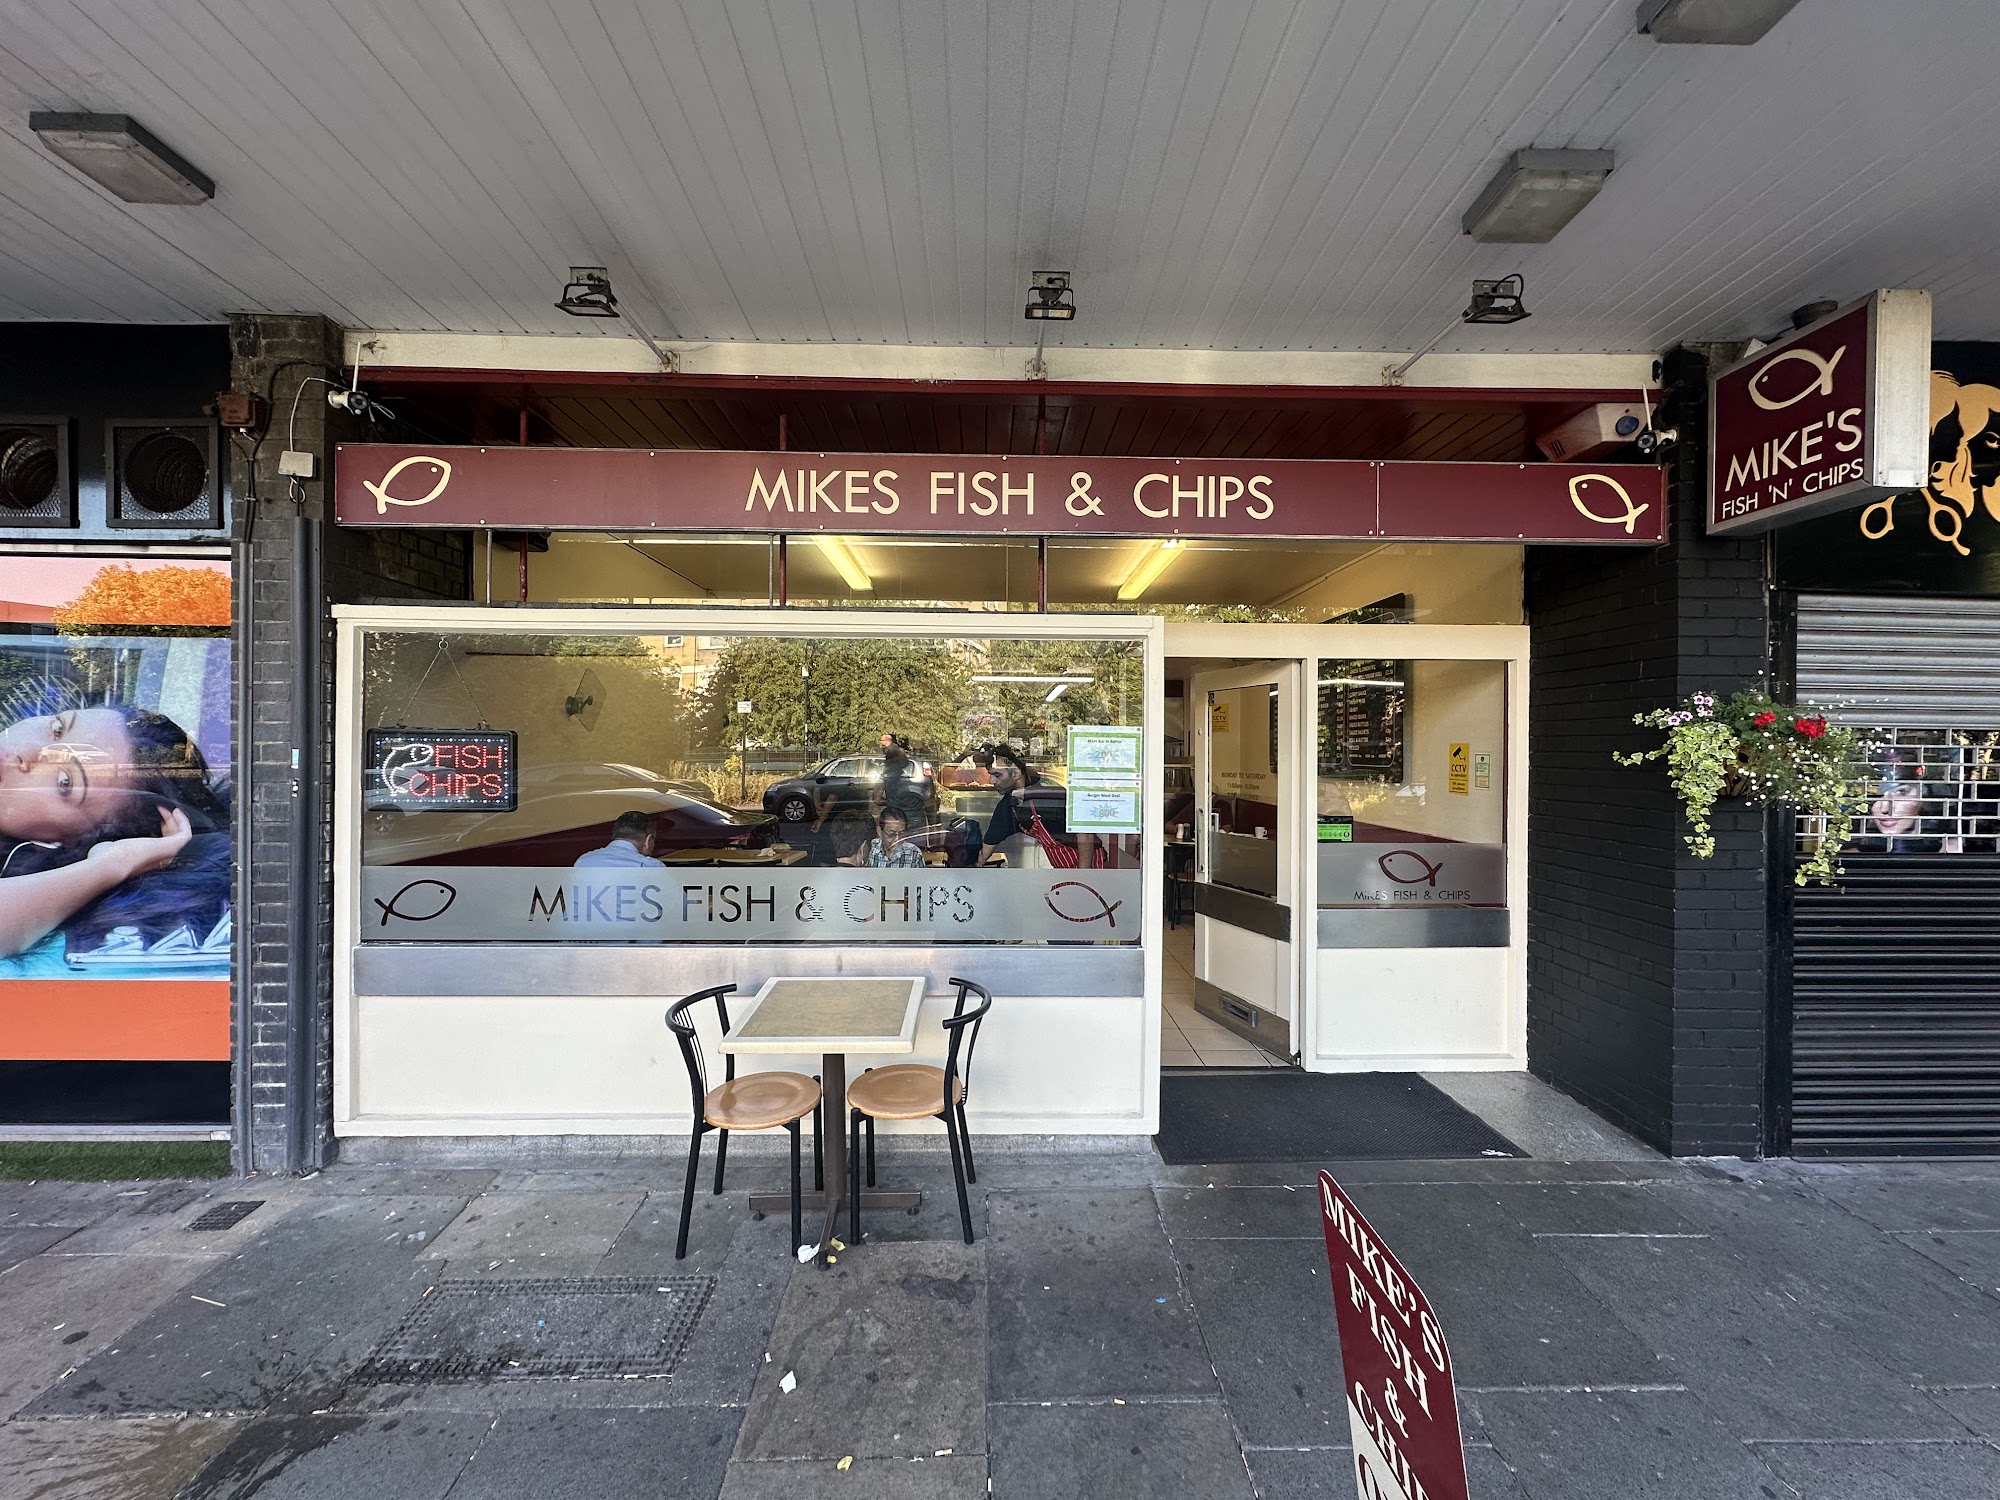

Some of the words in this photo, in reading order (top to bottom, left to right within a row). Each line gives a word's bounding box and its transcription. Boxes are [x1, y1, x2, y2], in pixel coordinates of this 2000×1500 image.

[1725, 407, 1862, 492] MIKE'S
[745, 468, 900, 515] MIKES
[931, 471, 1034, 517] FISH
[1064, 472, 1105, 517] &
[1134, 473, 1274, 520] CHIPS
[1722, 492, 1758, 519] FISH
[1768, 478, 1793, 503] 'N'
[1803, 458, 1864, 493] CHIPS
[434, 744, 503, 769] FISH
[1451, 764, 1466, 772] CCTV
[409, 772, 503, 797] CHIPS
[528, 884, 663, 923] MIKES
[682, 885, 775, 923] FISH
[795, 885, 826, 923] &
[843, 885, 975, 923] CHIPS
[1393, 890, 1417, 901] FISH
[1424, 890, 1432, 901] &
[1438, 890, 1471, 901] CHIPS
[1320, 1176, 1446, 1373] MIKE'S
[1346, 1262, 1433, 1421] FISH
[1384, 1377, 1409, 1439] &
